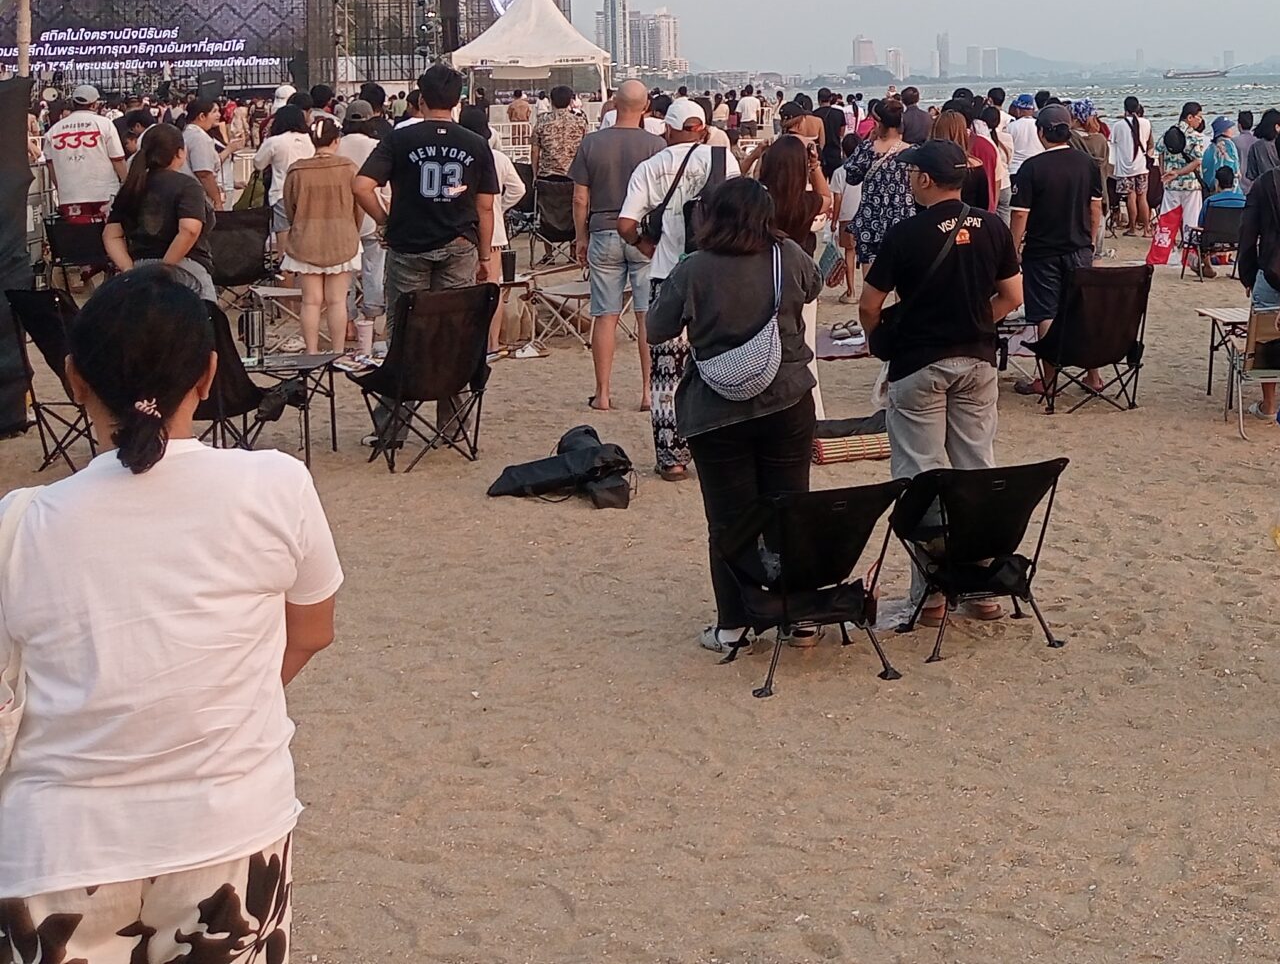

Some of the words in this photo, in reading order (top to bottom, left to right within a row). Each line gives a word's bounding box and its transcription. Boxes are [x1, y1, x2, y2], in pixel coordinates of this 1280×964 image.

[53, 131, 100, 150] 333
[409, 146, 436, 163] NEW
[441, 146, 474, 166] YORK
[420, 161, 463, 197] 03
